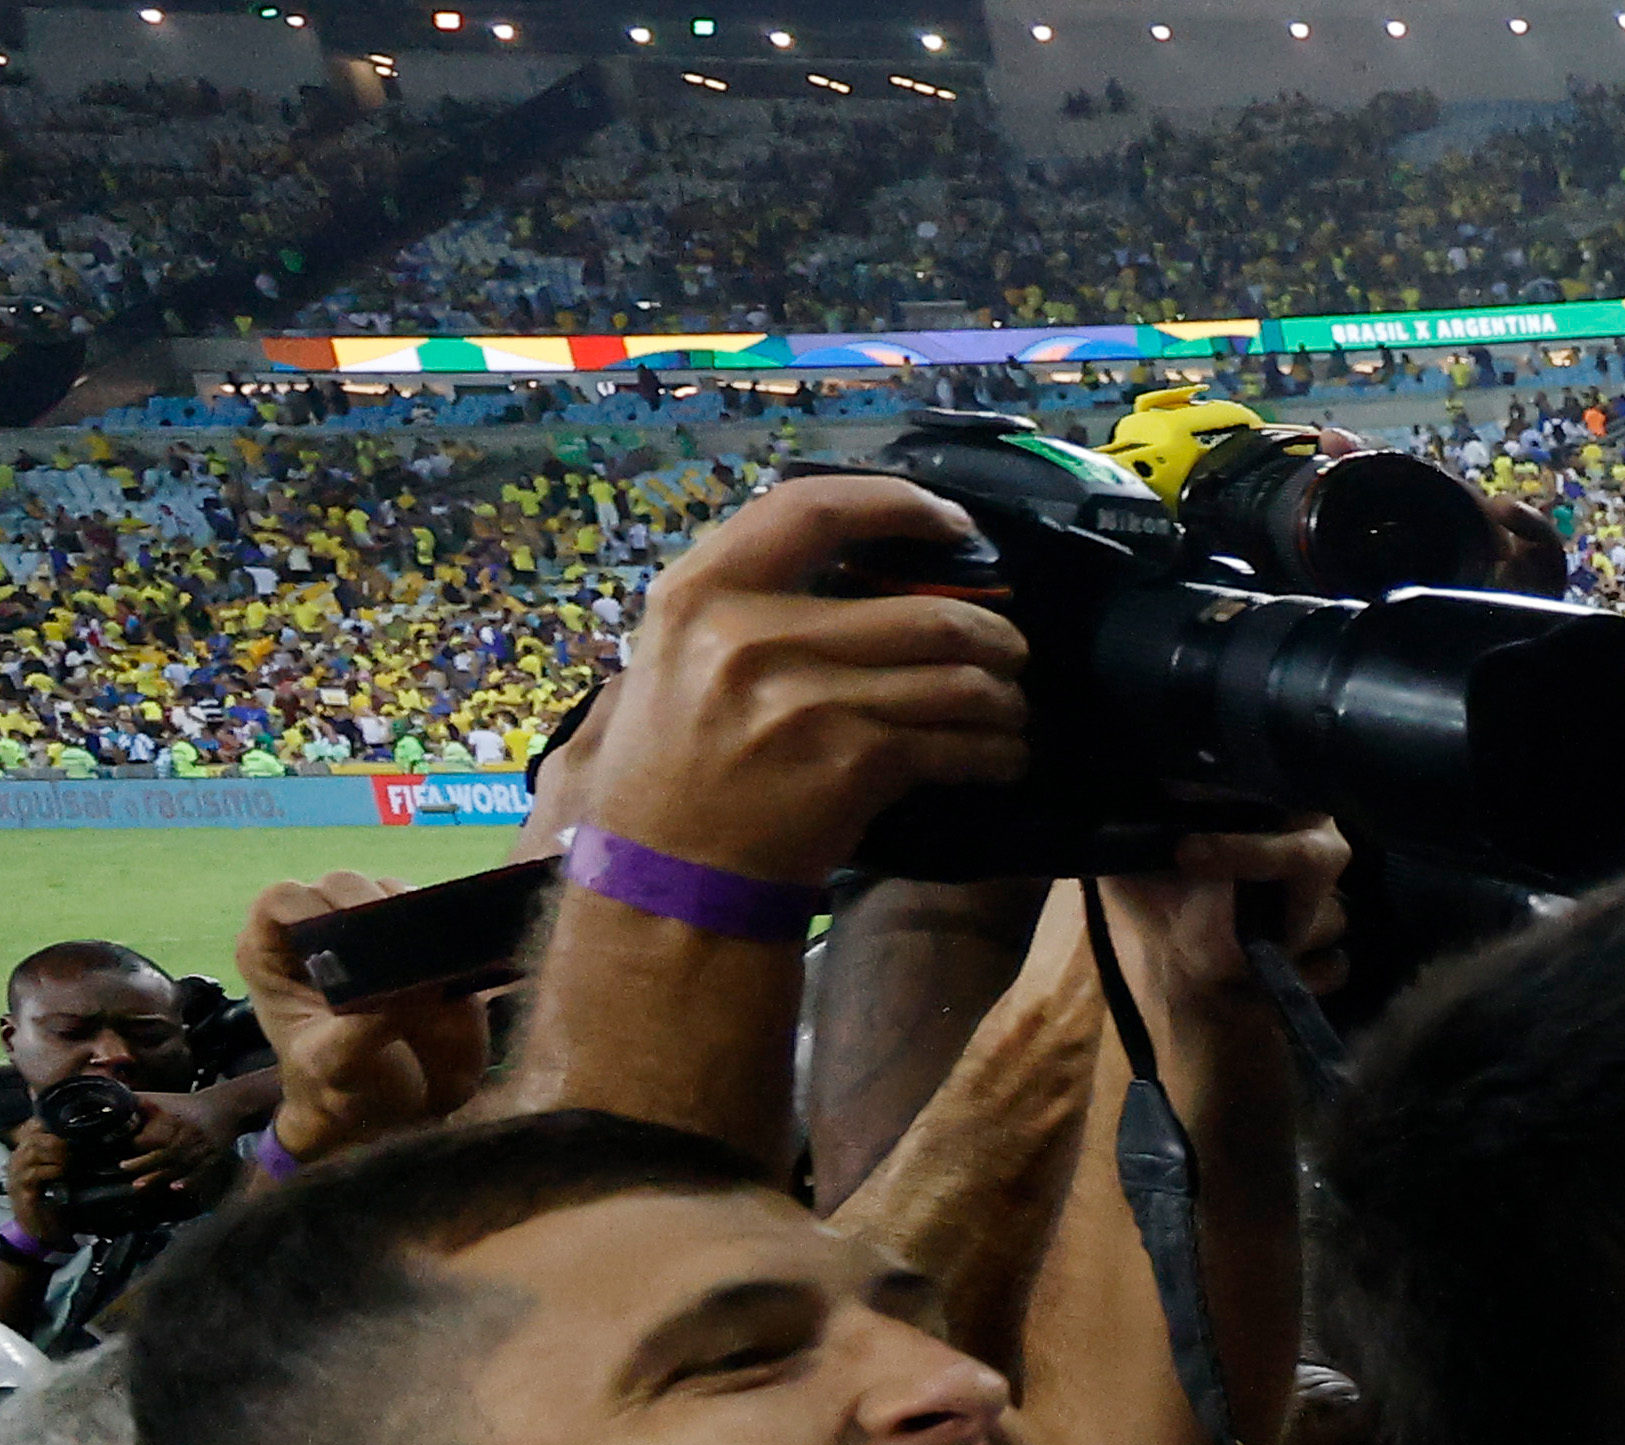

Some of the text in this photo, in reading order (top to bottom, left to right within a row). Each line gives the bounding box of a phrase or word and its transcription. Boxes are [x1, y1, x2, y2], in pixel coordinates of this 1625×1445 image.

[1331, 312, 1558, 344] BRASIL X ARGENTINA
[387, 781, 534, 815] FIFA WORL
